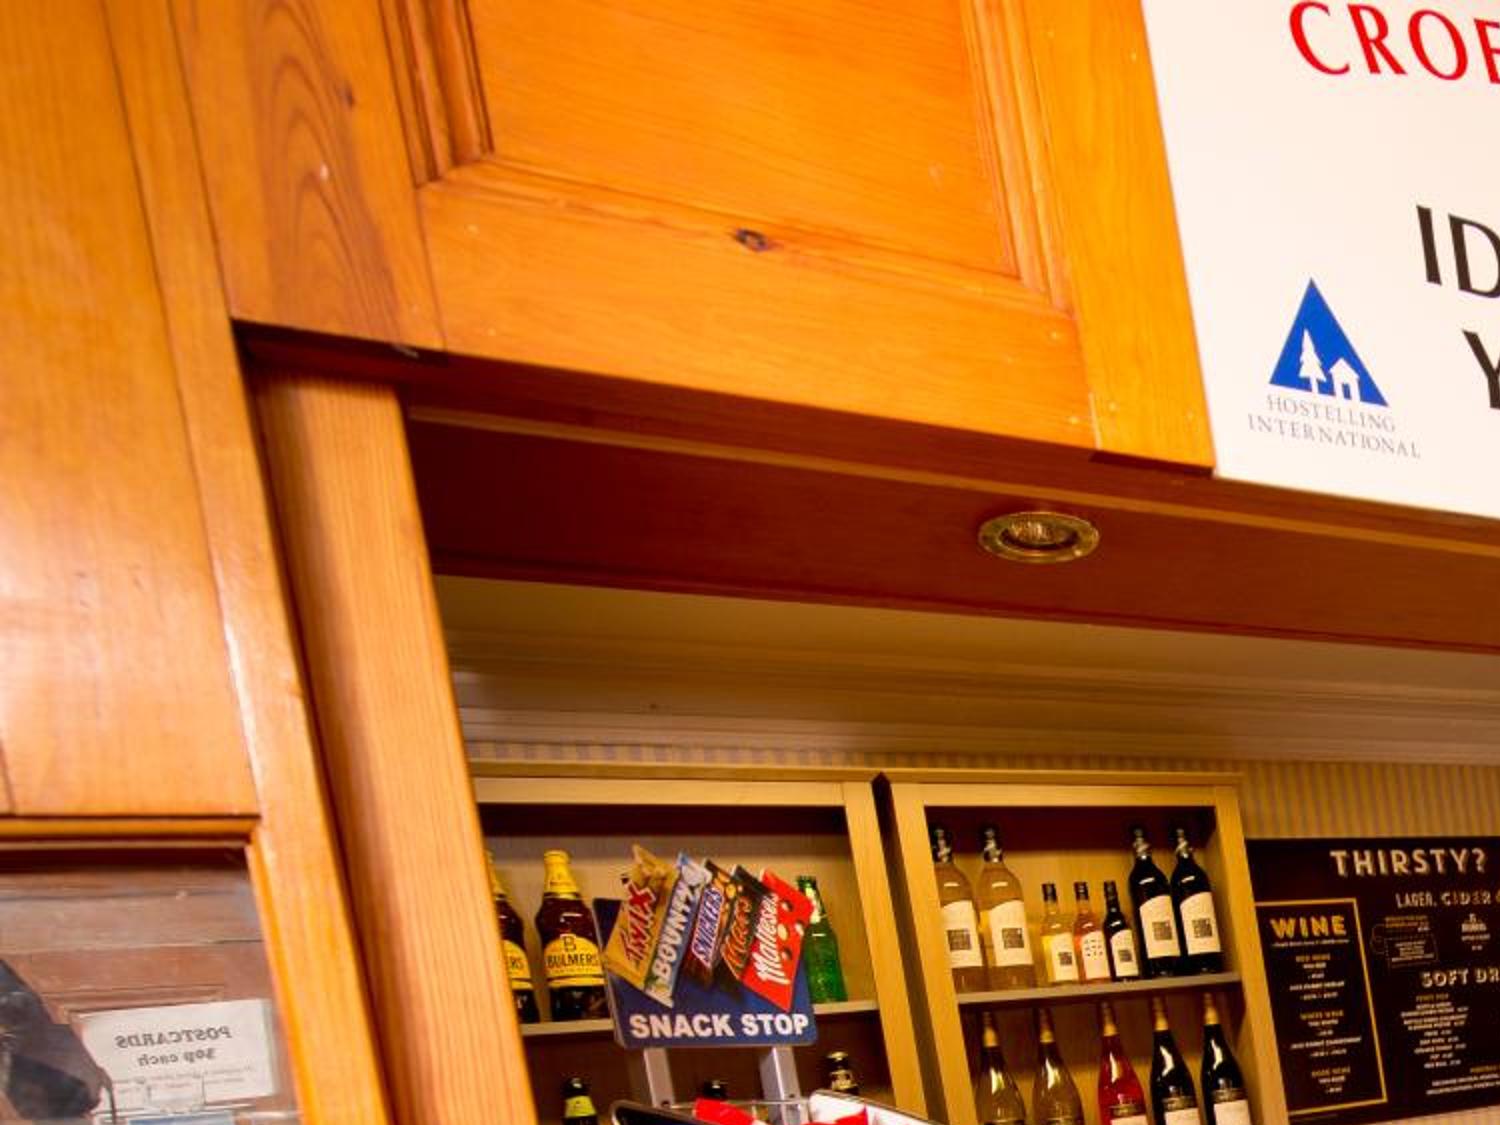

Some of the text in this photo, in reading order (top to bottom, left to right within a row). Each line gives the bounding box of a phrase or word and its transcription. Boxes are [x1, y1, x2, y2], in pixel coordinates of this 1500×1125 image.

[1266, 394, 1397, 434] HOSTELLING
[1248, 415, 1421, 459] INTERNATIONAL
[1330, 847, 1488, 877] THIRSTY?
[1441, 890, 1491, 905] CIDER
[652, 880, 695, 976] BOUNTY
[1270, 915, 1346, 939] WINE
[547, 953, 600, 970] BULMERS
[1421, 968, 1469, 988] SOFT
[629, 1013, 809, 1038] SNACK STOP
